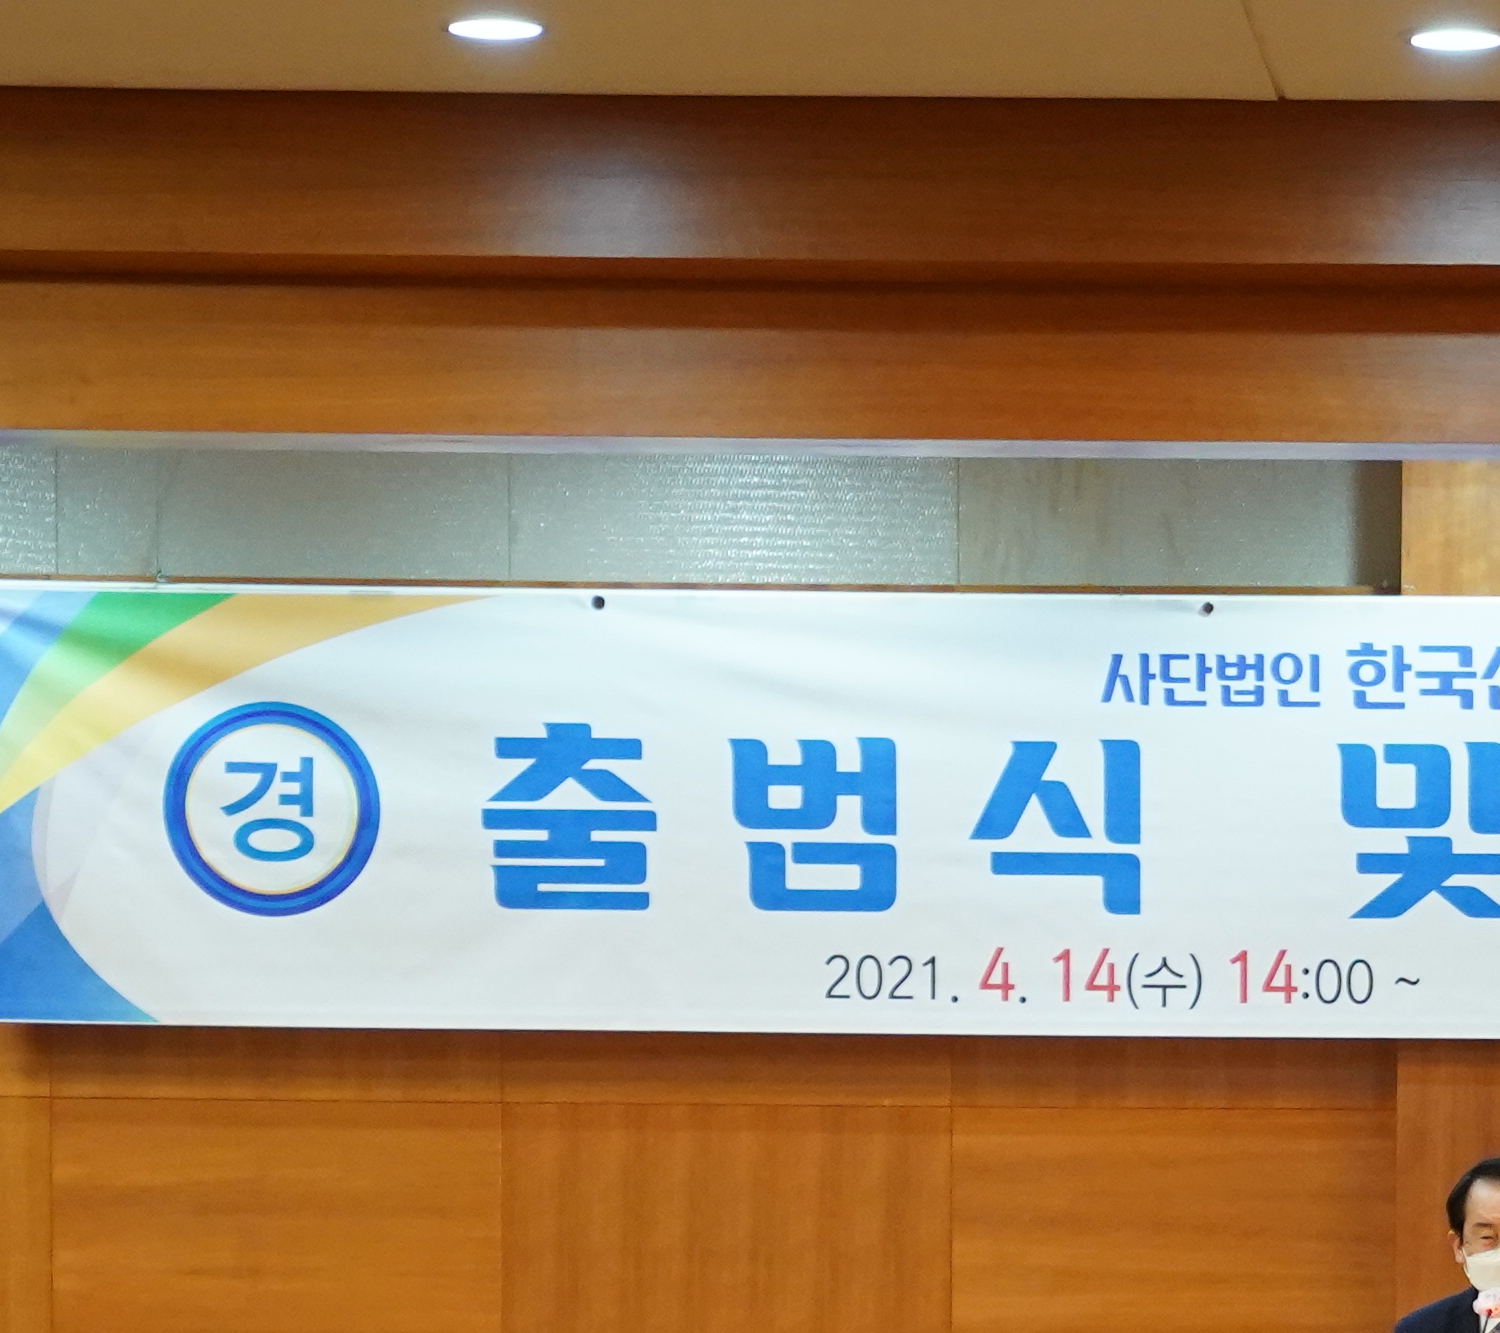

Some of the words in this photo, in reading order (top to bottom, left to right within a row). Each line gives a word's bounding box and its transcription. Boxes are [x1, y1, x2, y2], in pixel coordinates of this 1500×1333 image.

[1101, 653, 1320, 707] 사단법인
[219, 754, 320, 864] 경
[481, 722, 1144, 916] 출범식
[826, 955, 958, 1003] 2021.
[1053, 948, 1202, 1009] 14(수)
[1230, 950, 1373, 1004] 14:00
